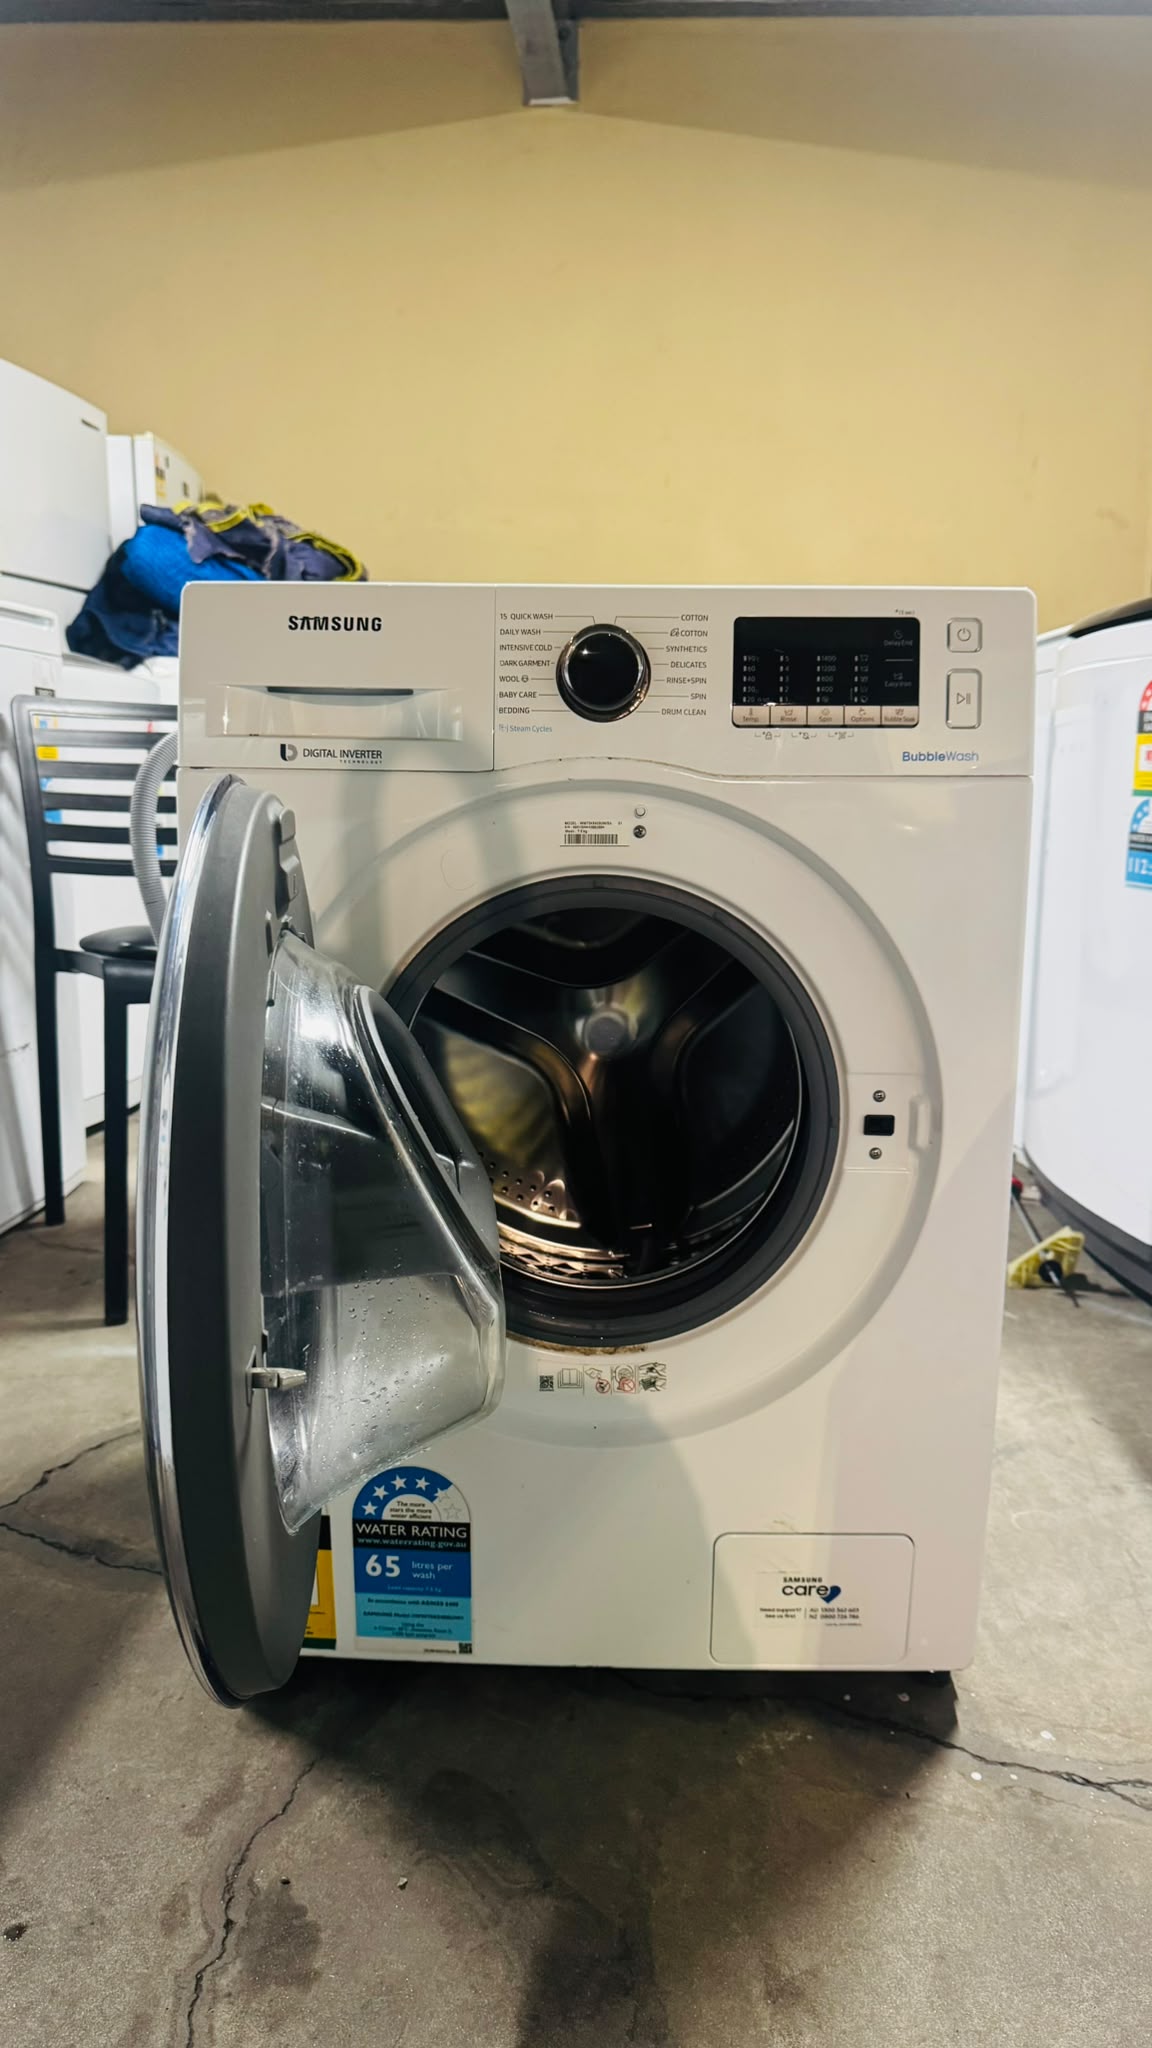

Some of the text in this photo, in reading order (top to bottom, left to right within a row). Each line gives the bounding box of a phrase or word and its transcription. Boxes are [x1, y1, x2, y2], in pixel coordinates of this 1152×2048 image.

[288, 615, 382, 632] SAMSUNG
[661, 708, 706, 716] DRUM CLEAN
[531, 725, 552, 733] Cycles
[303, 748, 382, 760] DIGITAL INVERTER
[902, 751, 979, 762] BubbleWash
[356, 1523, 467, 1538] WATER RATING
[358, 1538, 466, 1548] www.waterrating.gov.au
[366, 1554, 400, 1578] 65
[412, 1561, 452, 1572] litres per
[412, 1571, 436, 1580] wash
[782, 1585, 829, 1596] care
